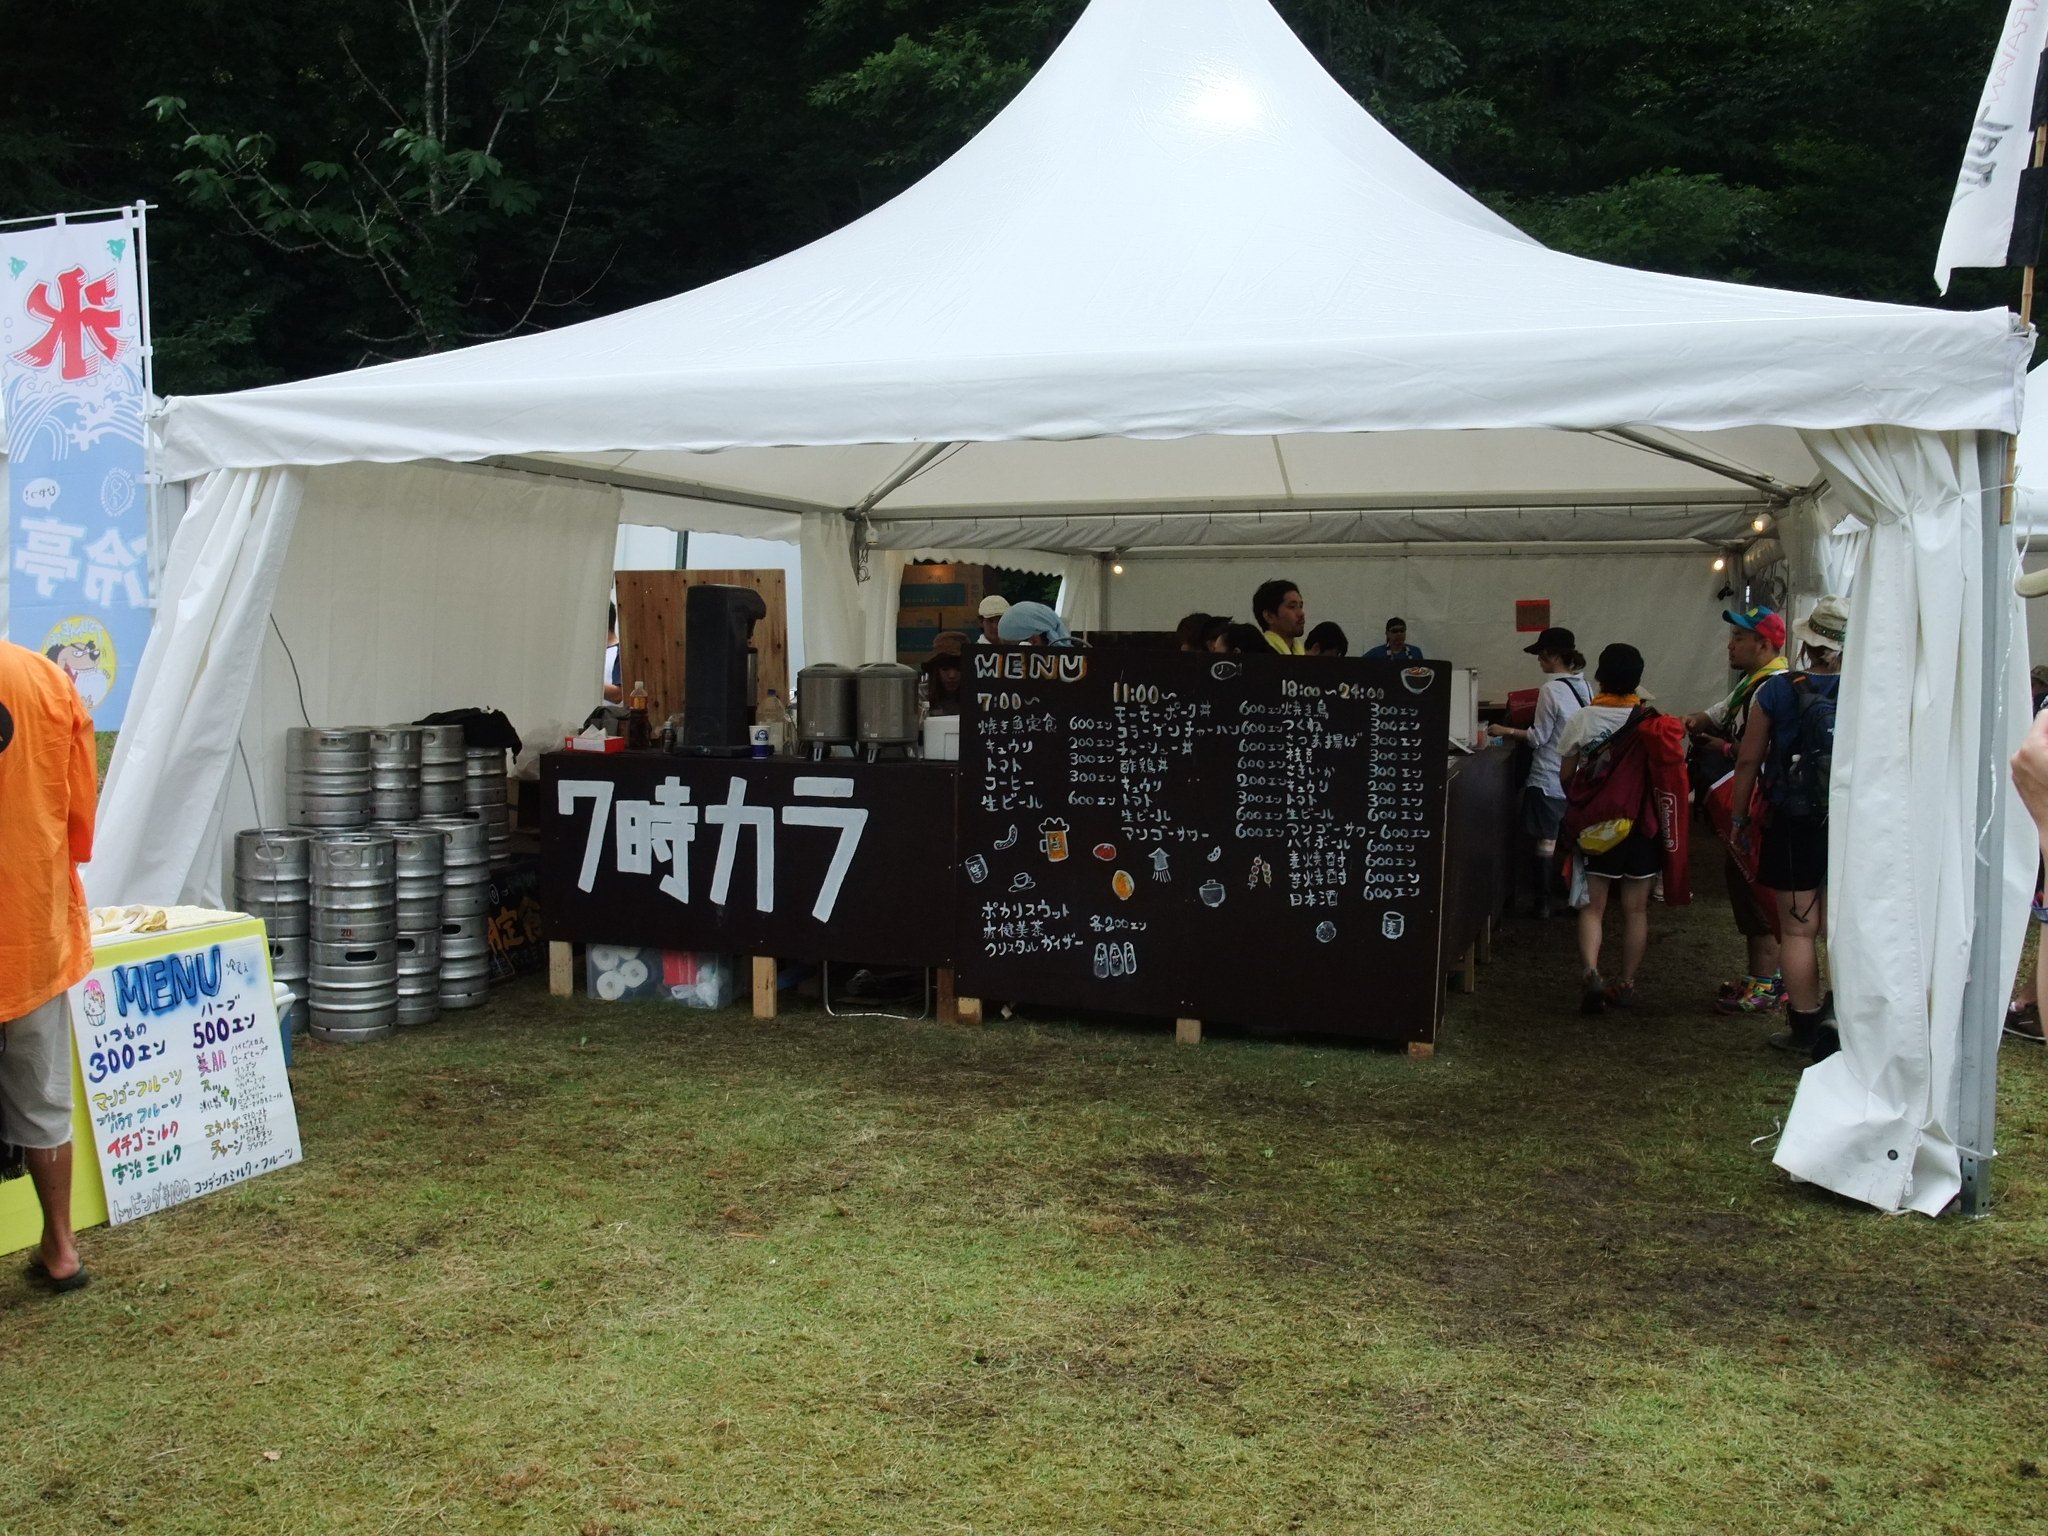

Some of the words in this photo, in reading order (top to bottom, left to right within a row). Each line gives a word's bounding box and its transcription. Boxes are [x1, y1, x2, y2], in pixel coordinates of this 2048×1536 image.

[975, 652, 1087, 683] MENU
[1282, 699, 1329, 719] 焼き鳥
[978, 713, 1057, 734] 焼き魚定食
[1282, 717, 1323, 732] つくね
[986, 738, 1033, 755] キュウリ
[987, 757, 1022, 773] トマト
[985, 775, 1034, 790] コーヒー
[1121, 775, 1162, 793] キュウリ
[1287, 779, 1328, 793] キュウリ
[981, 792, 1043, 811] 生ビール
[1122, 793, 1153, 807] トマト
[1287, 793, 1317, 805] トマト
[1121, 808, 1171, 822] 生ビール
[1286, 808, 1334, 820] 生ビール
[1121, 825, 1209, 841] マンゴーサワー
[1286, 821, 1376, 837] マンゴーサワー
[557, 775, 869, 923] 7時カラ
[1287, 835, 1350, 849] ハイボール
[1290, 889, 1338, 907] 日本酒
[112, 944, 222, 1018] MENU
[201, 994, 241, 1017] ハーブ
[95, 1022, 147, 1048] いつもの
[193, 1013, 256, 1049] 500エン
[88, 1040, 166, 1084] 300エン
[107, 1120, 179, 1158] イチゴミルク
